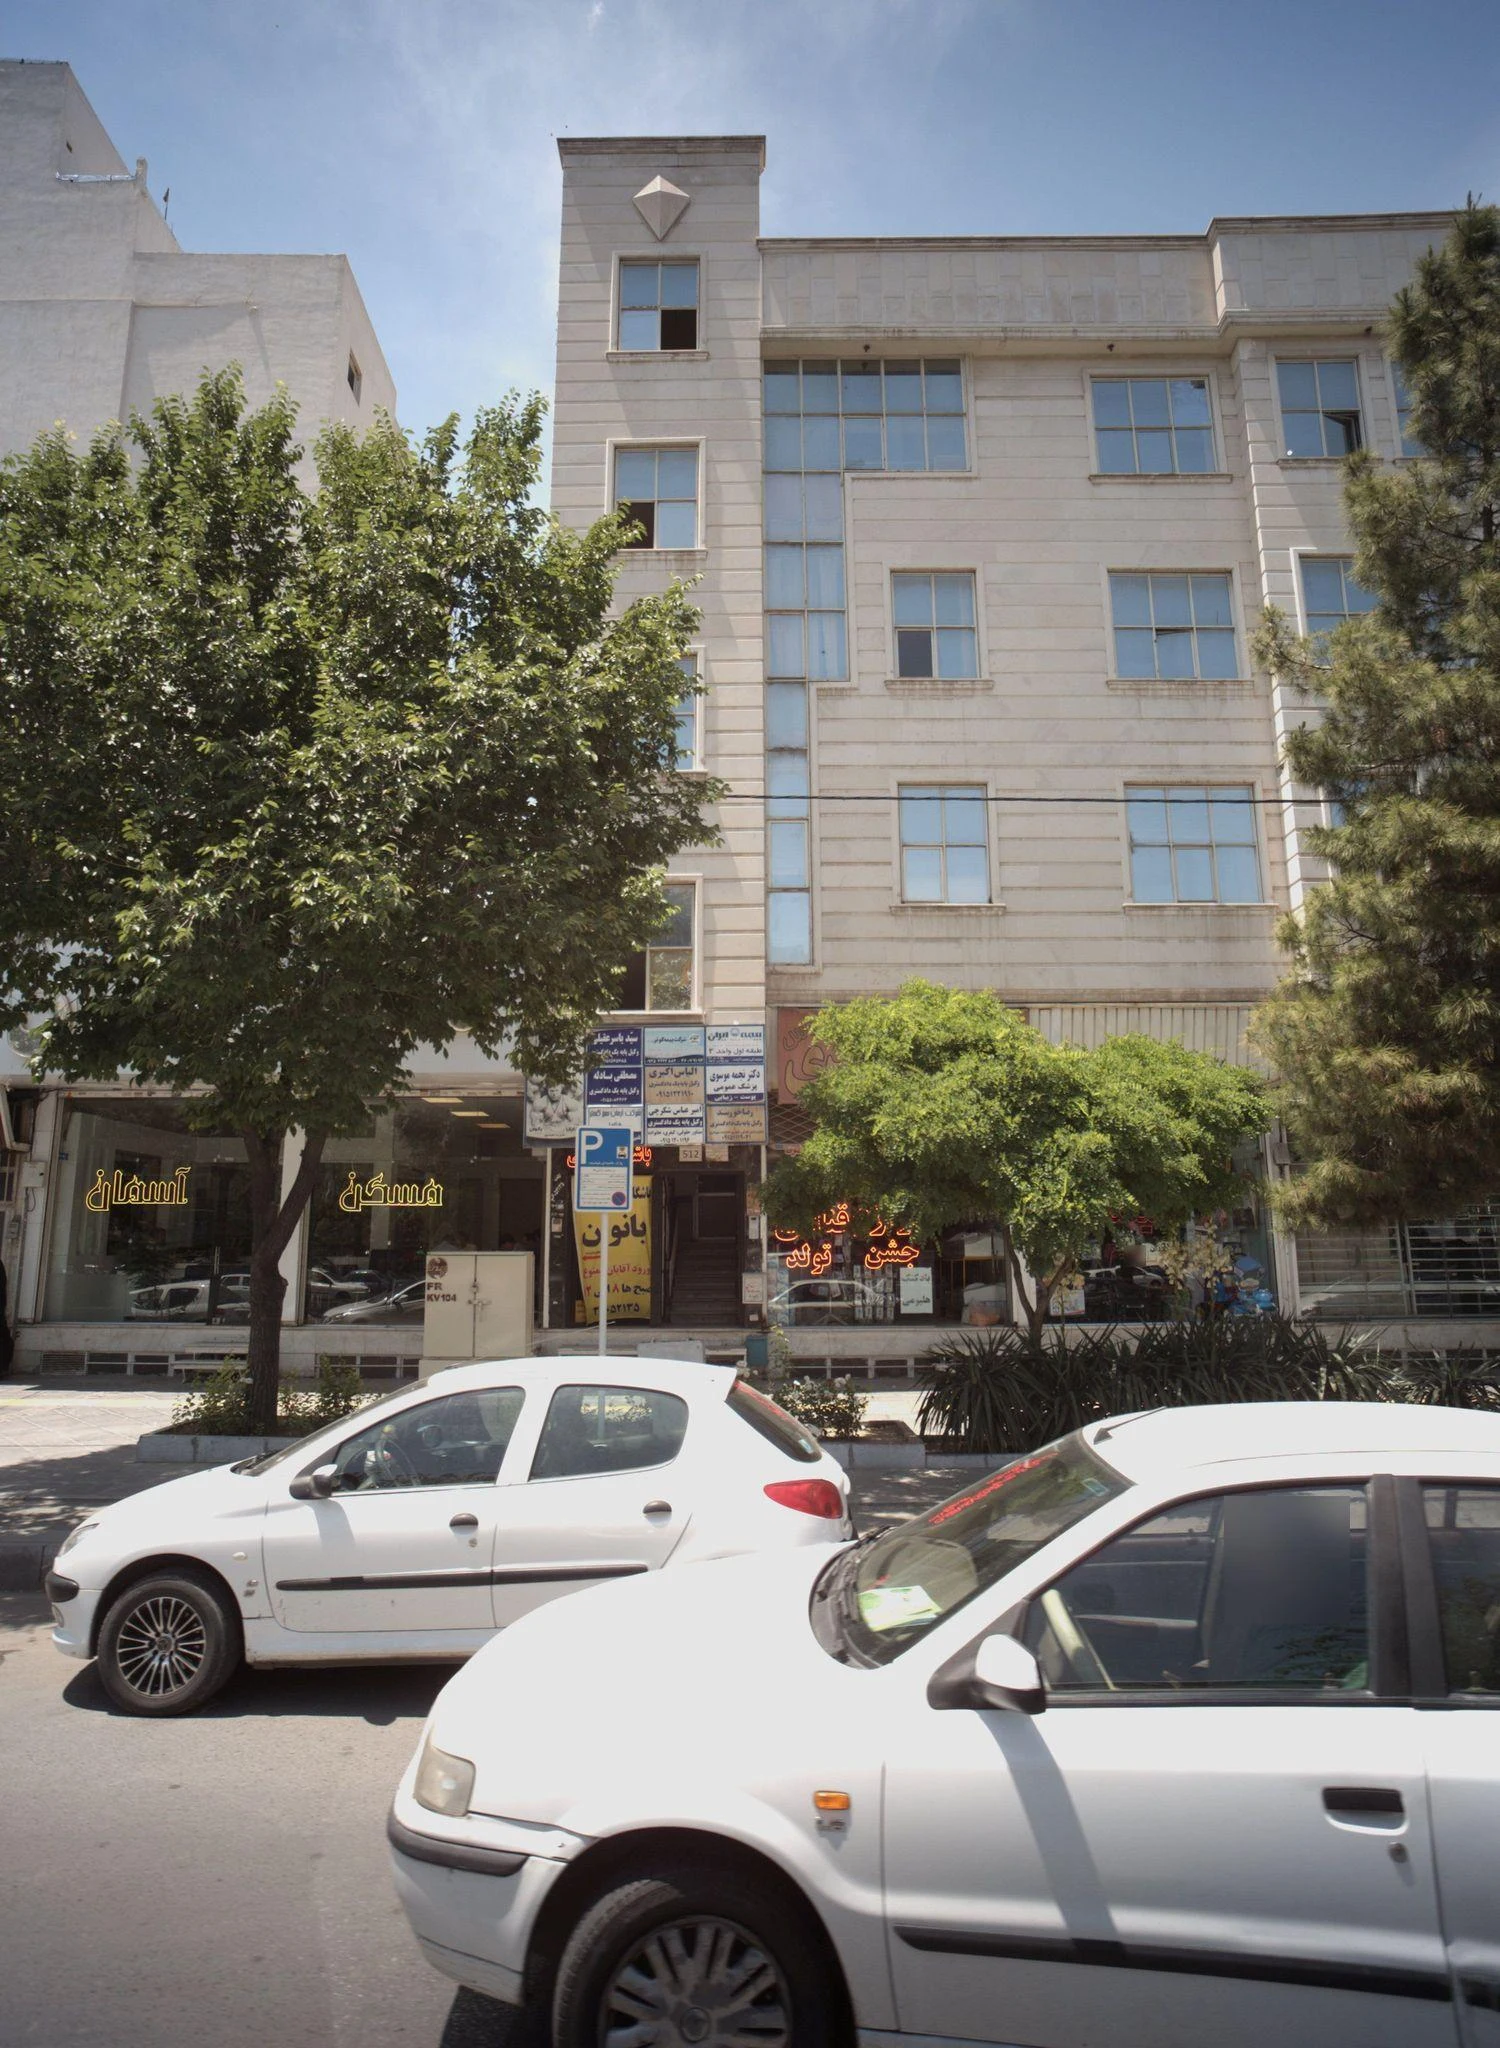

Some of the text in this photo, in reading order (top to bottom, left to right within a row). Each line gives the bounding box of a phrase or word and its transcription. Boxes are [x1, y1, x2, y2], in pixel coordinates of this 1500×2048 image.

[648, 1067, 698, 1080] الیاس اکبری
[709, 1069, 760, 1082] دکتر نجمه موسوی
[588, 1087, 611, 1096] دادگستری
[713, 1083, 758, 1092] پزشک عمومی
[581, 1130, 603, 1165] P
[682, 1149, 699, 1159] 512
[85, 1166, 192, 1212] آسمان
[339, 1171, 444, 1212] مسکن
[582, 1213, 647, 1248] بانون
[785, 1238, 920, 1275] جشن تولد
[427, 1282, 443, 1291] FR
[612, 1284, 619, 1292] ۸
[426, 1293, 457, 1302] KV104
